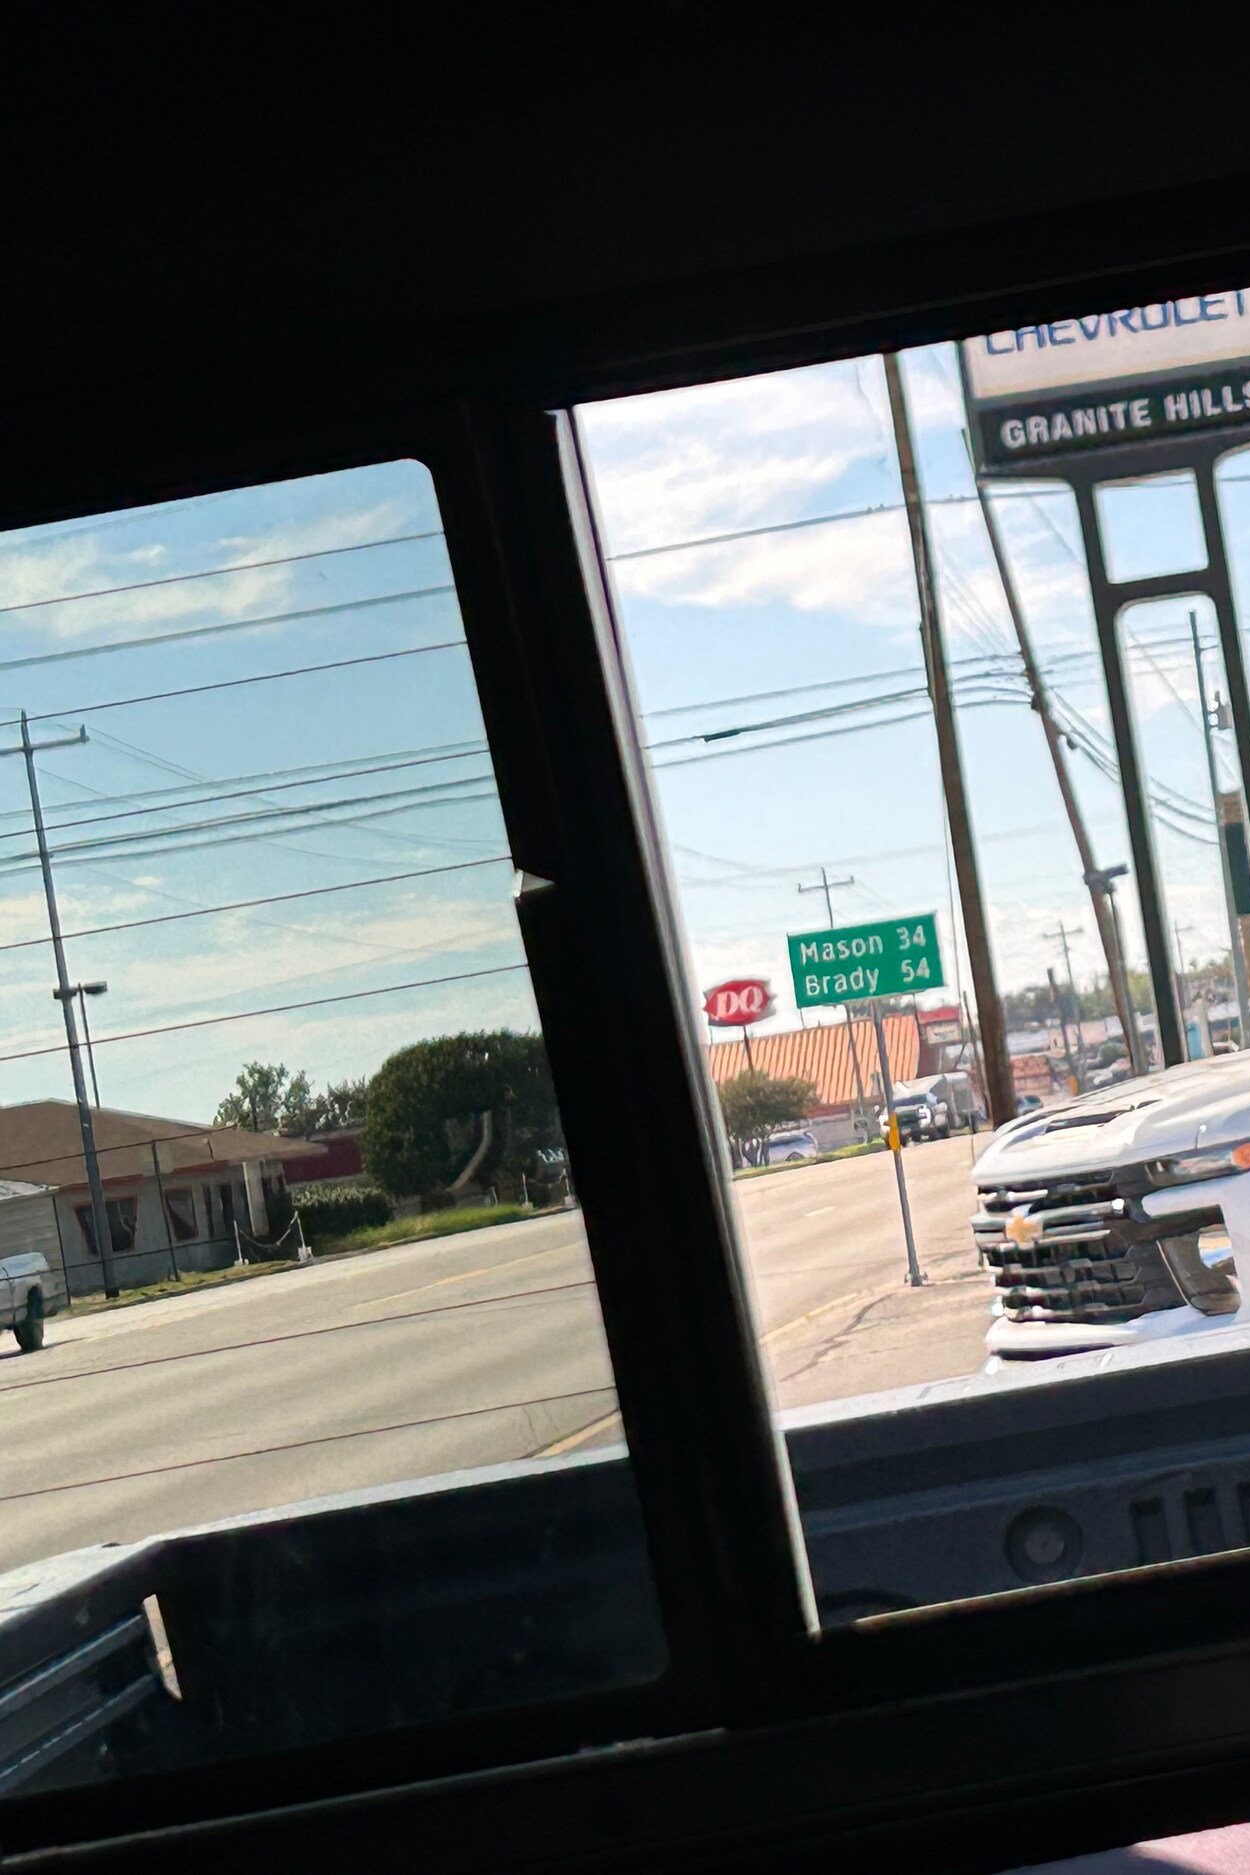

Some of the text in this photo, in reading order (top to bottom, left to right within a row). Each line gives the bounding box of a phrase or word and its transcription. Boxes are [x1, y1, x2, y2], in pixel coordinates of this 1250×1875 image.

[985, 289, 1245, 355] CHEVROLET
[1001, 398, 1152, 449] GRANITE
[800, 925, 927, 966] Mason 34
[805, 957, 931, 996] Brady 54
[714, 986, 763, 1017] DQ
